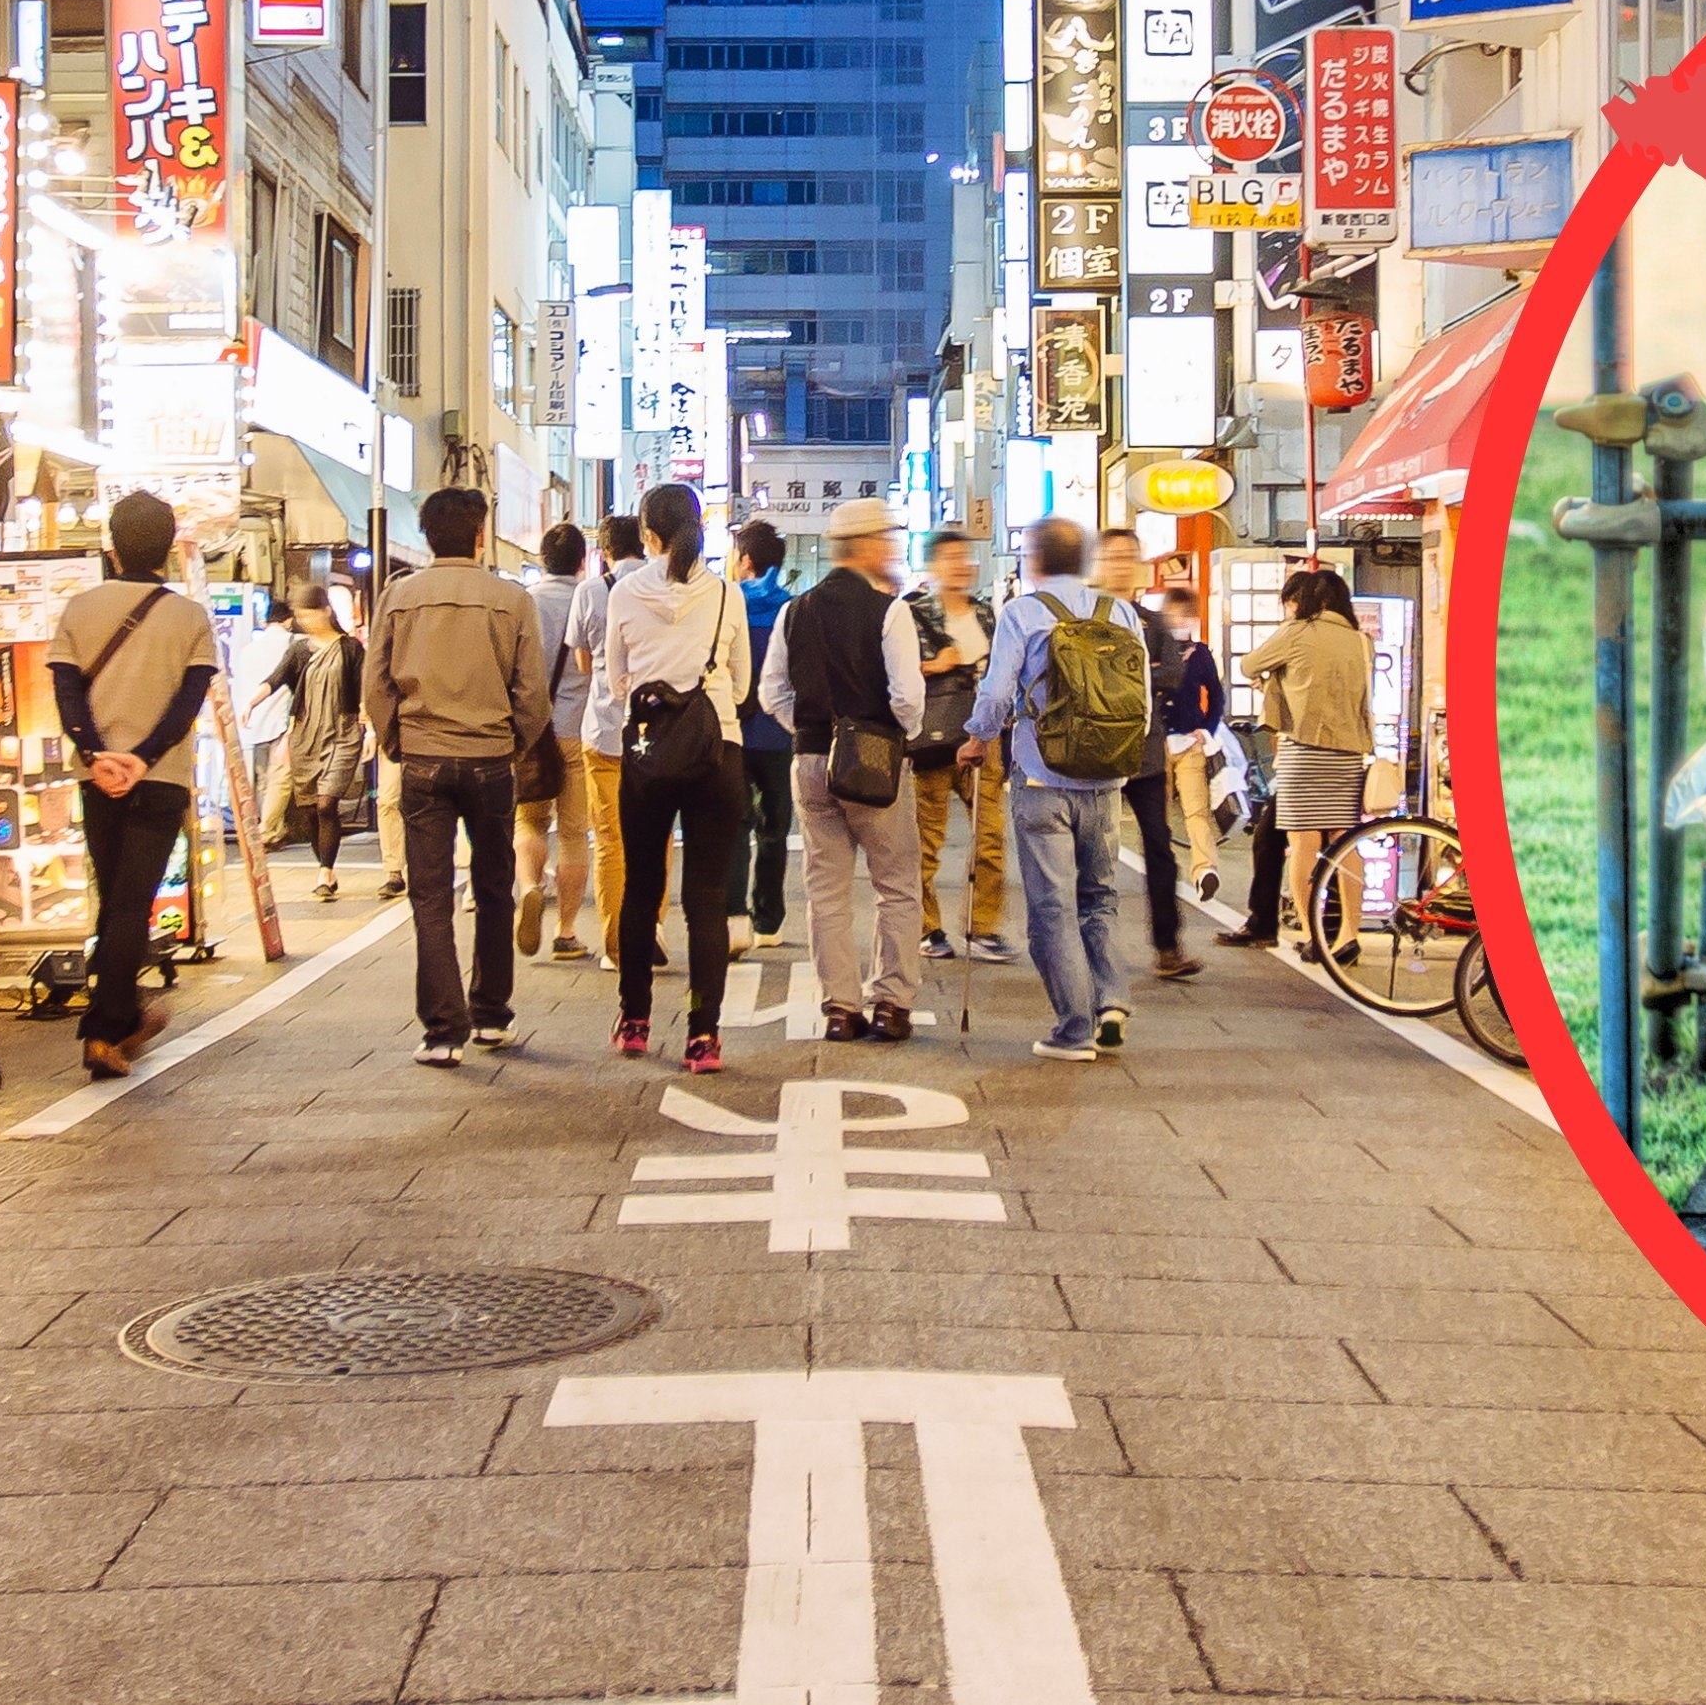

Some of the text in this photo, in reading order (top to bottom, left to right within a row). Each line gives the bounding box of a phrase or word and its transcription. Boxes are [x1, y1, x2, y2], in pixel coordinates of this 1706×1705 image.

[1148, 116, 1189, 142] 3F
[1210, 107, 1278, 140] 消火栓
[1320, 58, 1350, 188] だるまや
[1352, 46, 1370, 196] ジンギスカン
[1371, 45, 1391, 196] 炭火焼生ラム
[1196, 180, 1265, 205] BLG
[1050, 205, 1115, 236] 2F
[1321, 213, 1391, 226] 新宿西口店
[1343, 228, 1369, 240] 2F
[1046, 246, 1119, 280] 個室
[1150, 289, 1194, 314] 2F
[1052, 322, 1091, 423] 清香苑
[1334, 318, 1365, 396] だるまや
[545, 412, 569, 423] 2F
